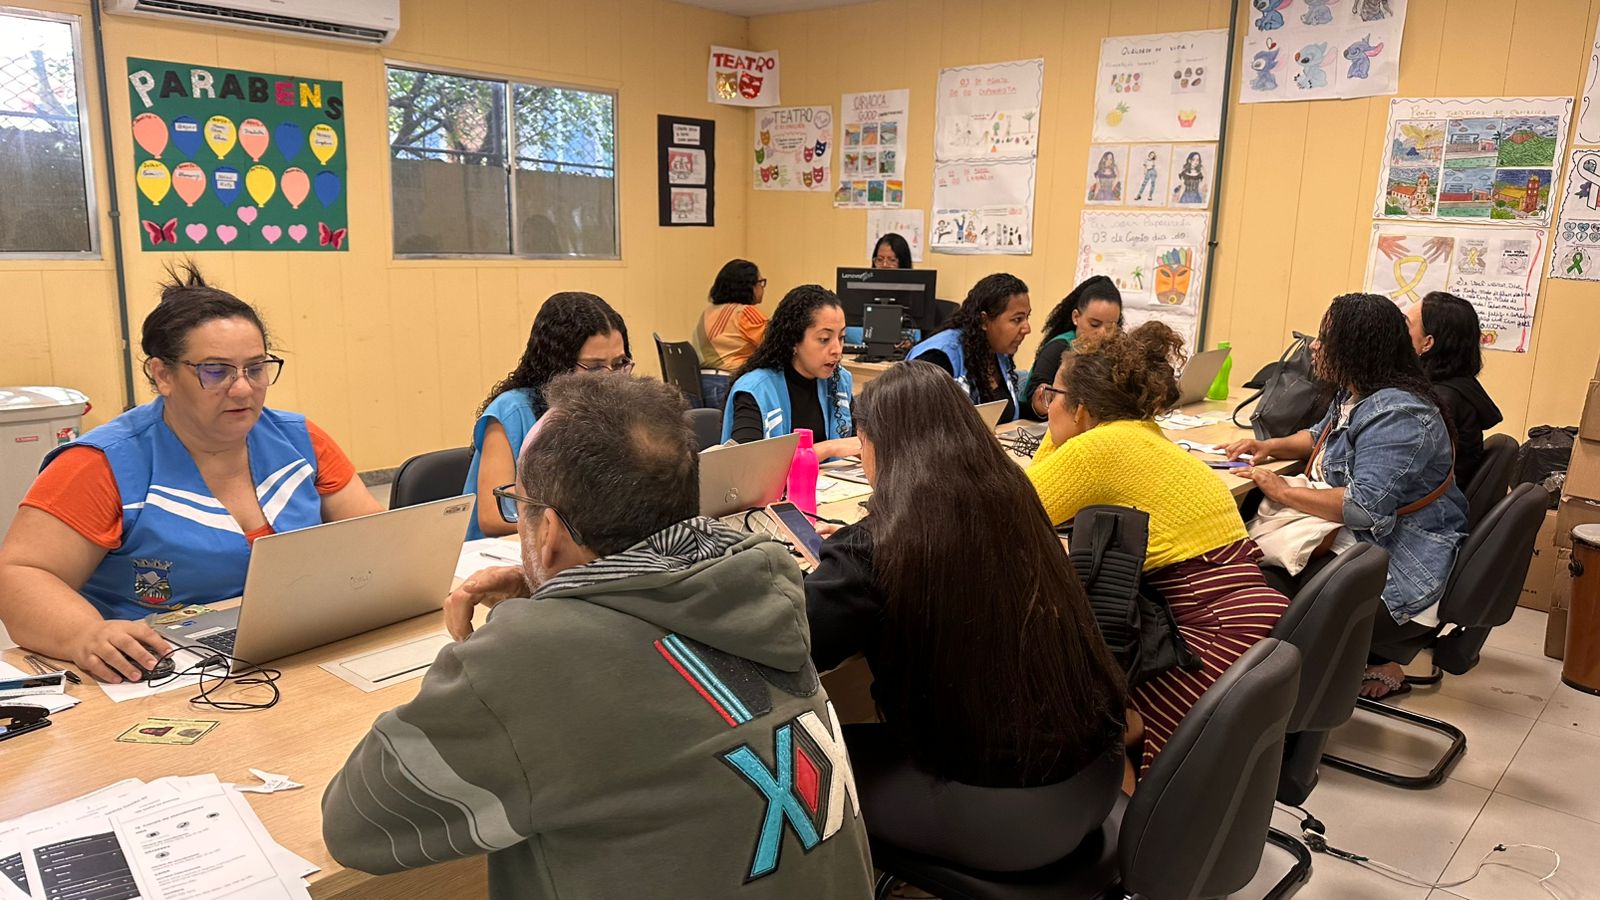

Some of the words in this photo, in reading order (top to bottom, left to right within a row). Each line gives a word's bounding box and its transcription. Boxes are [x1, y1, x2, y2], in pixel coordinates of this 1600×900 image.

[713, 53, 775, 73] TEATRO
[771, 107, 813, 124] TEATRO
[1092, 231, 1107, 243] 03
[1111, 233, 1123, 243] de
